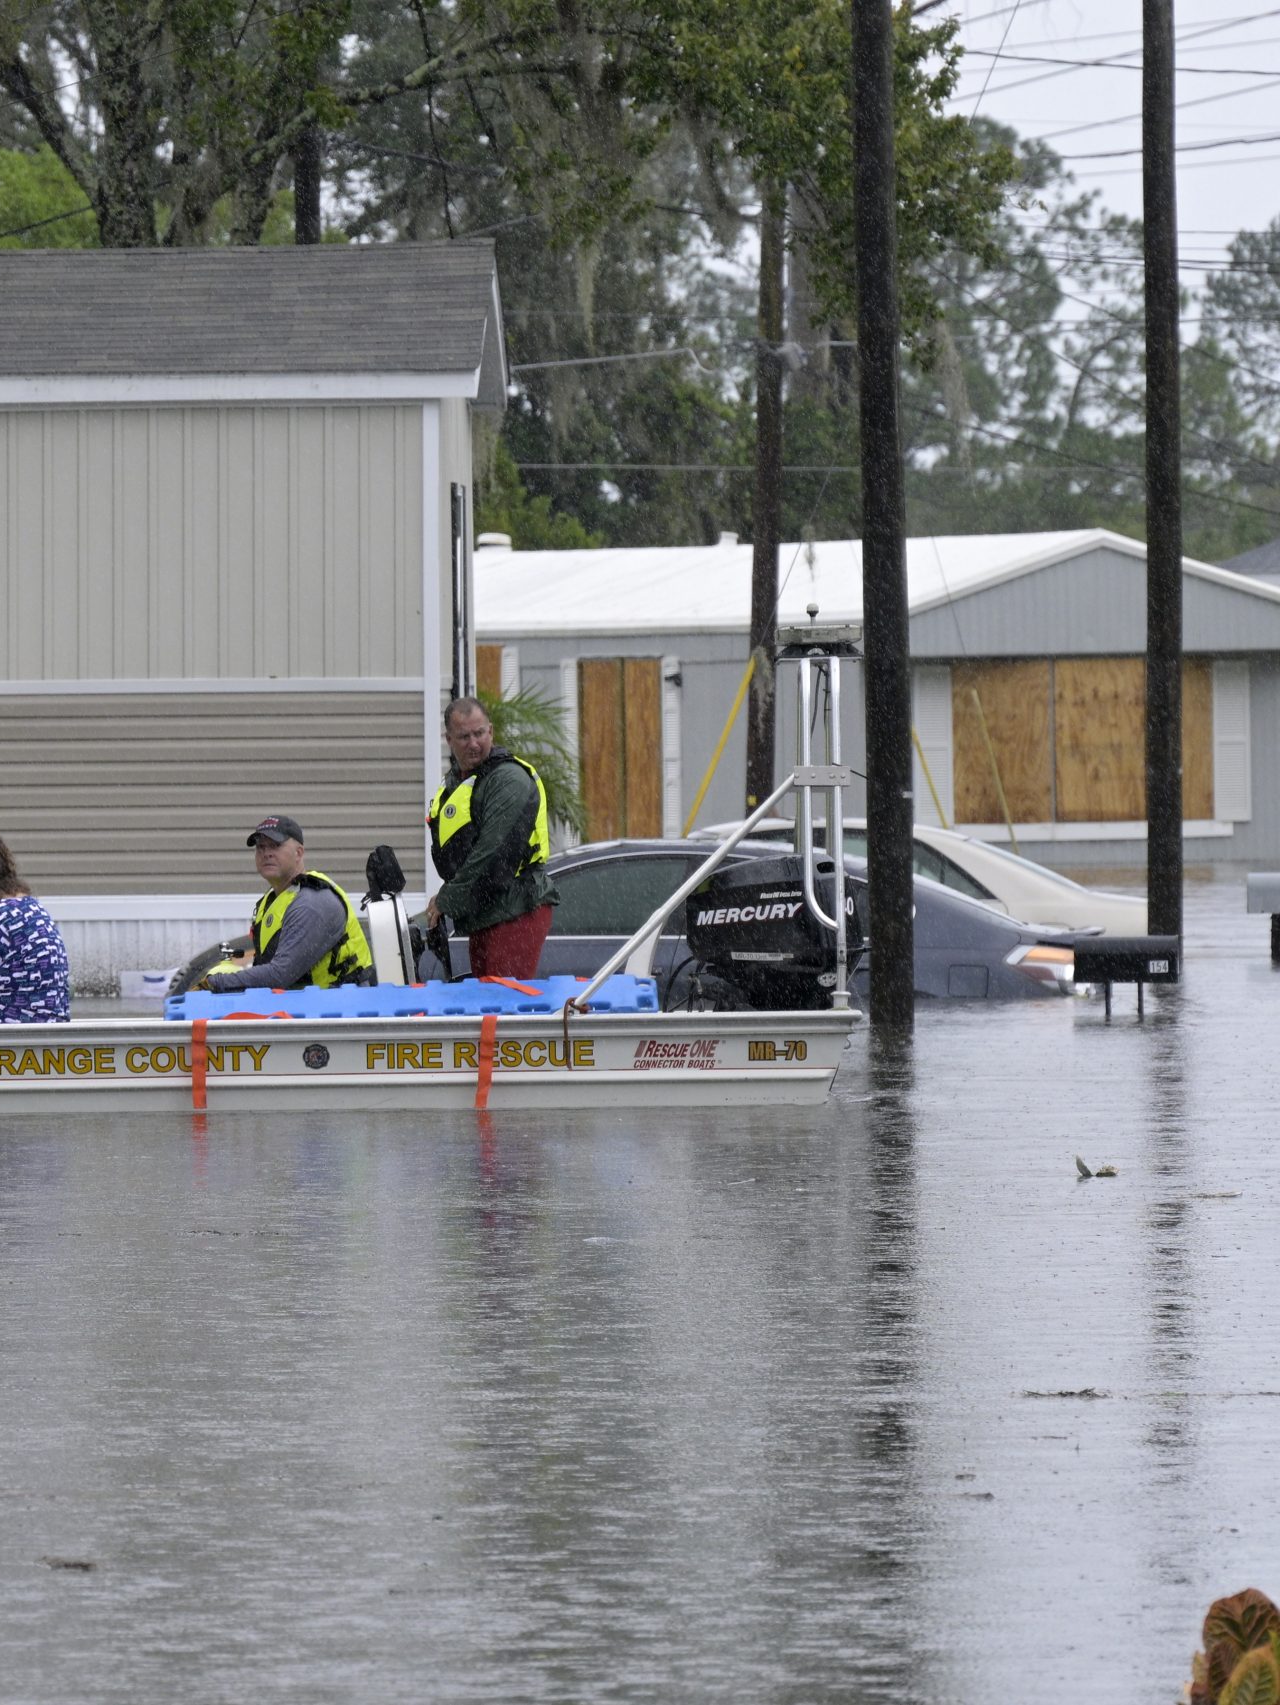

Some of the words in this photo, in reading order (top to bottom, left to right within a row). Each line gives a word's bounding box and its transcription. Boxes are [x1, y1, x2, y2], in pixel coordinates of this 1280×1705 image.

[697, 902, 804, 926] MERCURY
[1151, 962, 1167, 972] 154
[125, 1045, 270, 1073] COUNTY
[366, 1042, 443, 1069] FIRE
[748, 1040, 808, 1061] MR-70
[634, 1060, 686, 1069] CONNECTOR
[687, 1060, 716, 1069] BOATS
